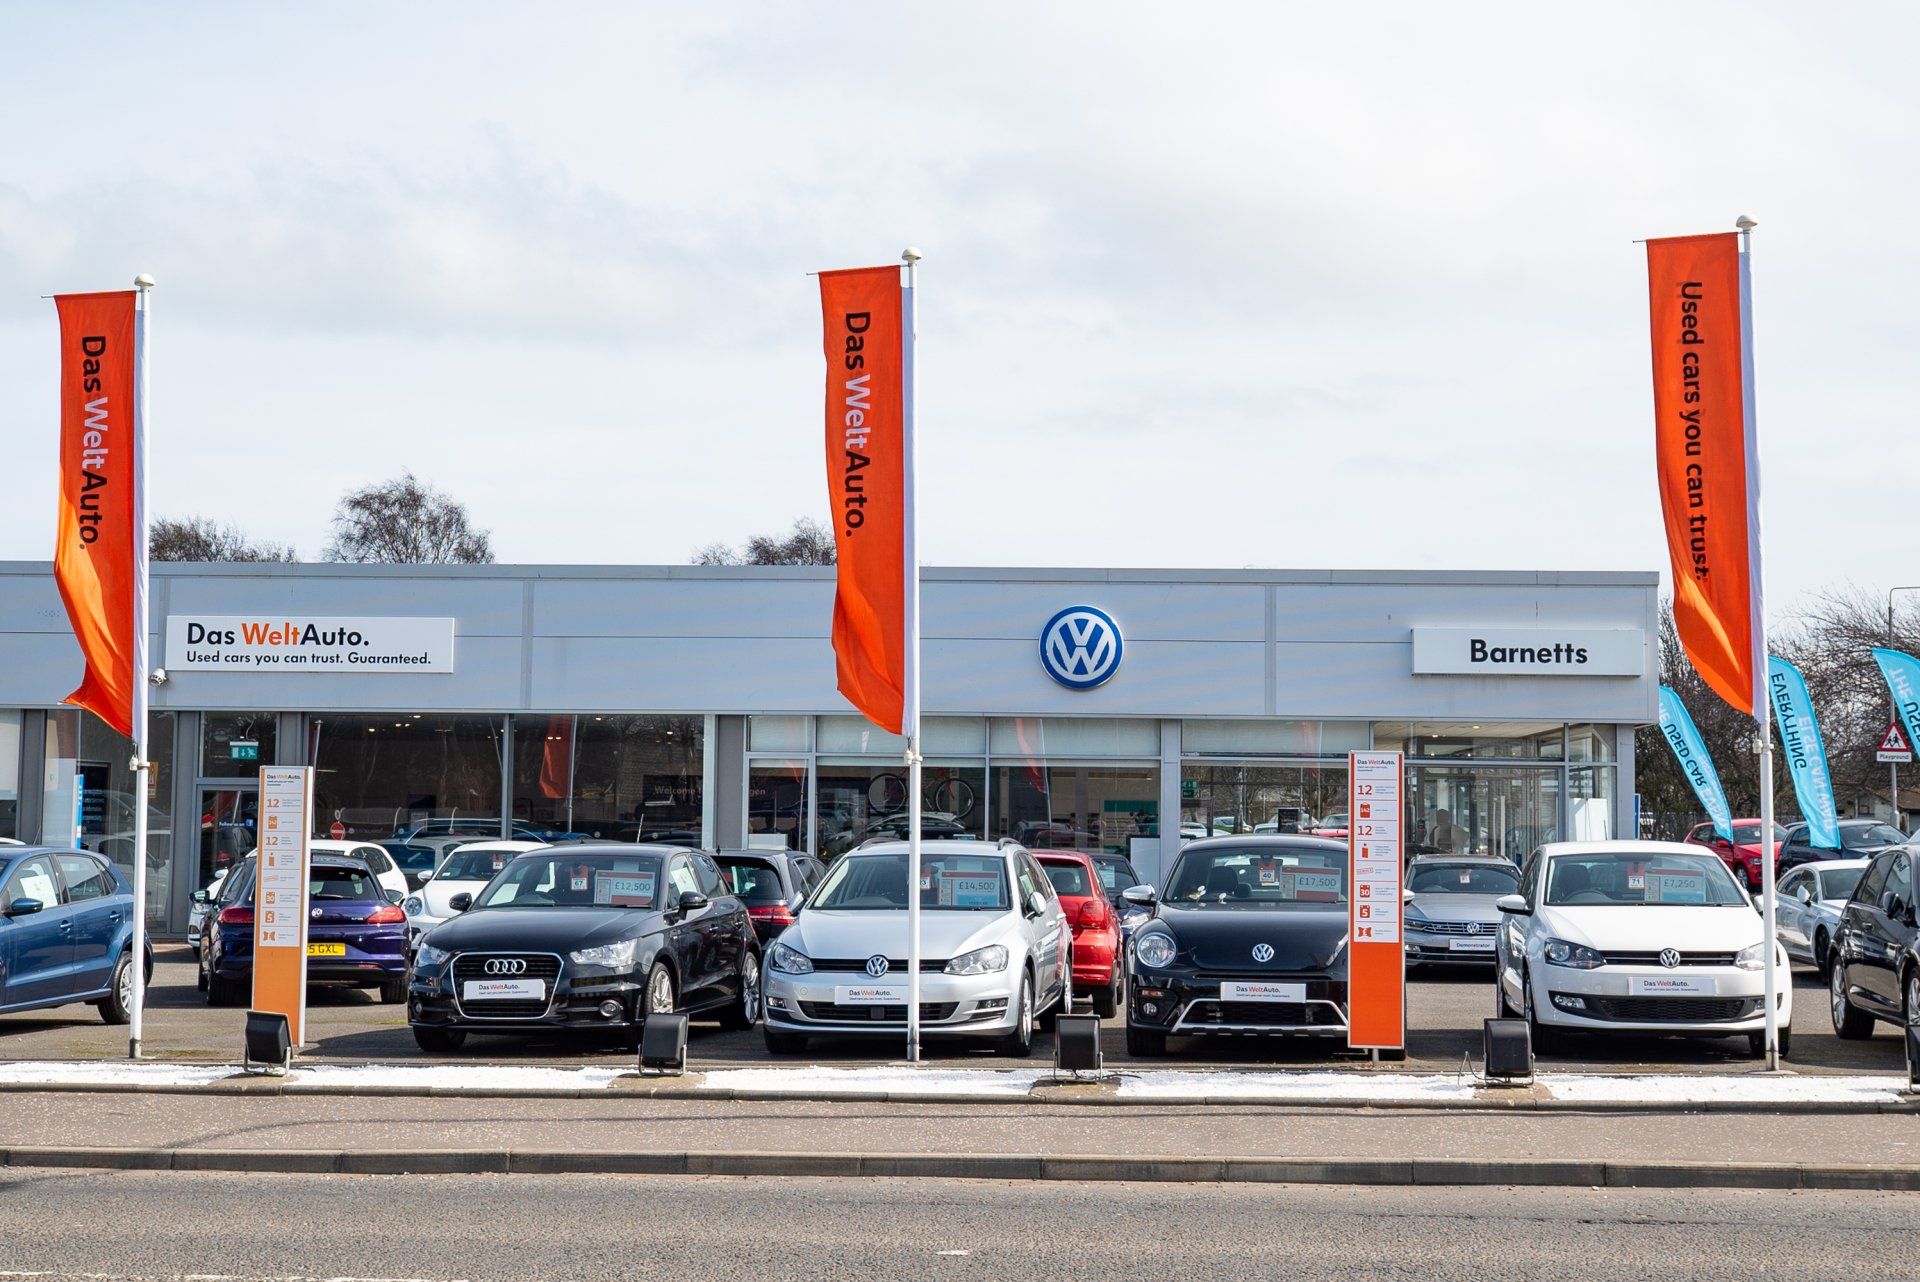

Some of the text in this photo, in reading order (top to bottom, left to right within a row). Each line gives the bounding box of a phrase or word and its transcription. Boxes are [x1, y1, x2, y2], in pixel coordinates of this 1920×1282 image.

[1680, 281, 1705, 346] Used
[845, 311, 871, 370] Das
[82, 335, 107, 393] Das
[1681, 352, 1702, 404] cars
[1679, 408, 1702, 456] you
[1685, 463, 1704, 508] can
[187, 622, 235, 645] Das
[1470, 638, 1588, 664] Barnetts
[186, 651, 432, 667] Used cars you can trust. Guaranteed.
[1357, 785, 1372, 795] 12
[267, 798, 280, 808] 12
[1357, 825, 1372, 836] 12
[265, 836, 279, 846] 12
[615, 882, 651, 892] £12,500
[959, 881, 995, 890] £14,500
[1300, 877, 1337, 887] £17,500
[1664, 879, 1696, 888] £7,250
[318, 944, 338, 953] GXL
